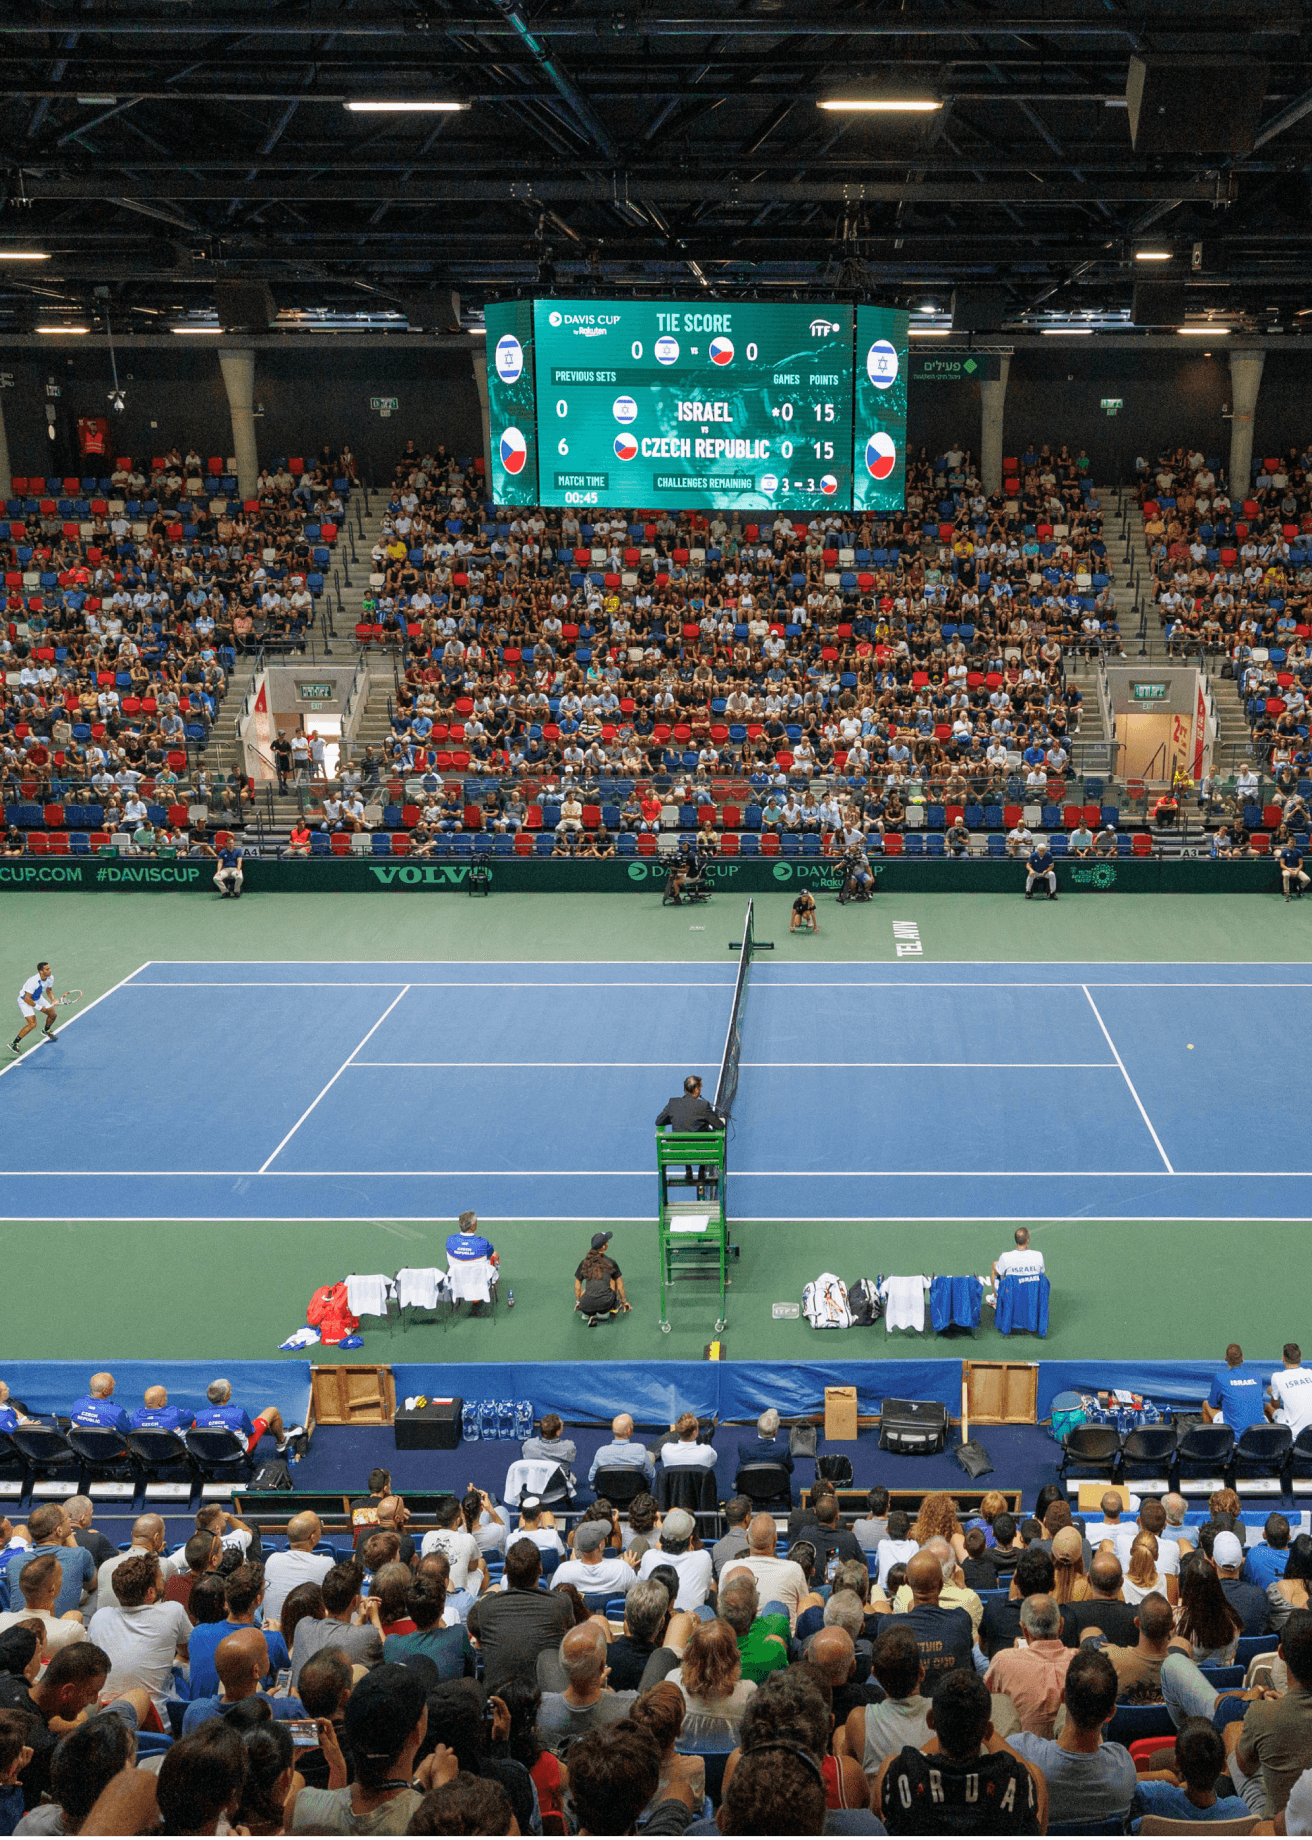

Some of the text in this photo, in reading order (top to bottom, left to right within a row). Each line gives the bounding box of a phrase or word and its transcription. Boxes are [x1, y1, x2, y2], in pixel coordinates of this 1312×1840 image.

[564, 315, 620, 325] DAVIS CUP
[656, 313, 732, 333] TIE SCORE
[579, 326, 607, 337] Rakuten
[811, 325, 831, 338] ITF
[631, 340, 644, 360] 0
[746, 342, 758, 361] 0
[923, 360, 961, 371] פעילים
[555, 371, 617, 382] PREVIOUS SETS
[773, 374, 839, 386] GAMES POINTS
[556, 399, 568, 418] 0
[677, 401, 733, 422] ISRAEL
[813, 403, 835, 422] 15
[557, 438, 569, 456] 6
[641, 437, 770, 459] CZECH REPUBLIC
[781, 440, 794, 459] 0
[813, 441, 835, 460] 15
[558, 475, 606, 487] MATCH TIME
[657, 477, 752, 489] CHALLENGES REMAINING
[781, 477, 790, 492] 3
[807, 478, 815, 492] 3
[565, 491, 598, 504] 00:45
[243, 848, 258, 857] A4
[1182, 849, 1197, 857] A3
[96, 867, 200, 882] #DAVISCUP
[705, 865, 739, 877] CUP
[892, 920, 923, 956] TEL AVIV
[1011, 1265, 1037, 1273] ISRAEL
[1019, 1275, 1040, 1284] ISRAEL
[1230, 1378, 1257, 1386] ISRAEL
